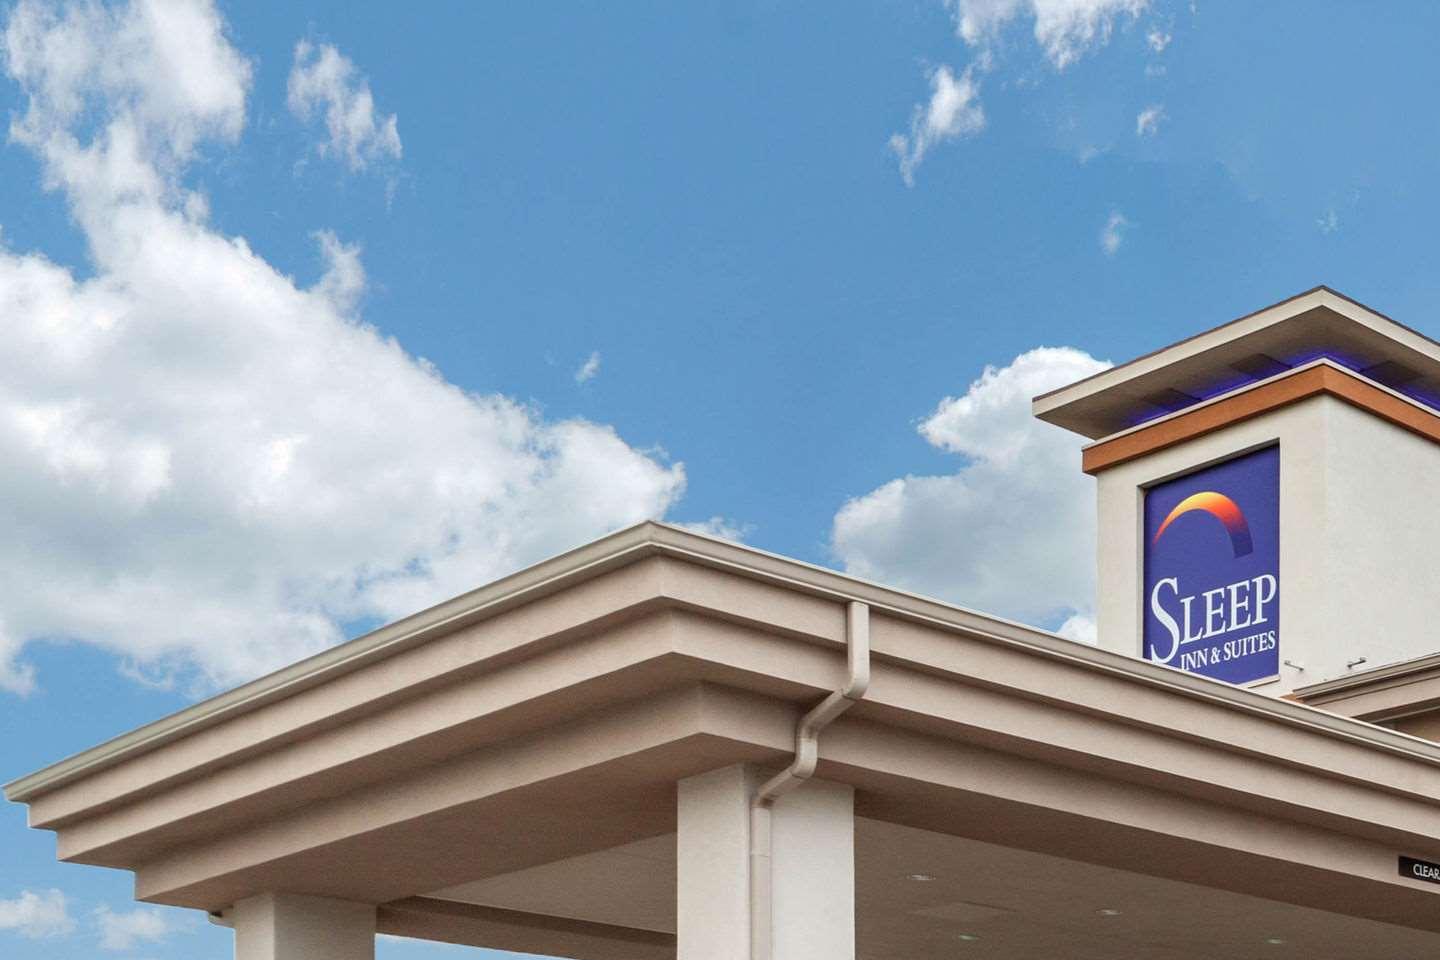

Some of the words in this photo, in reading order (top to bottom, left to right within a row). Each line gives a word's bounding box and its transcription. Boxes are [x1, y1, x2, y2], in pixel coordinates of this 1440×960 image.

[1151, 573, 1277, 665] SLEEP
[1180, 648, 1208, 671] INN
[1210, 646, 1221, 664] &
[1223, 630, 1276, 661] SUITES
